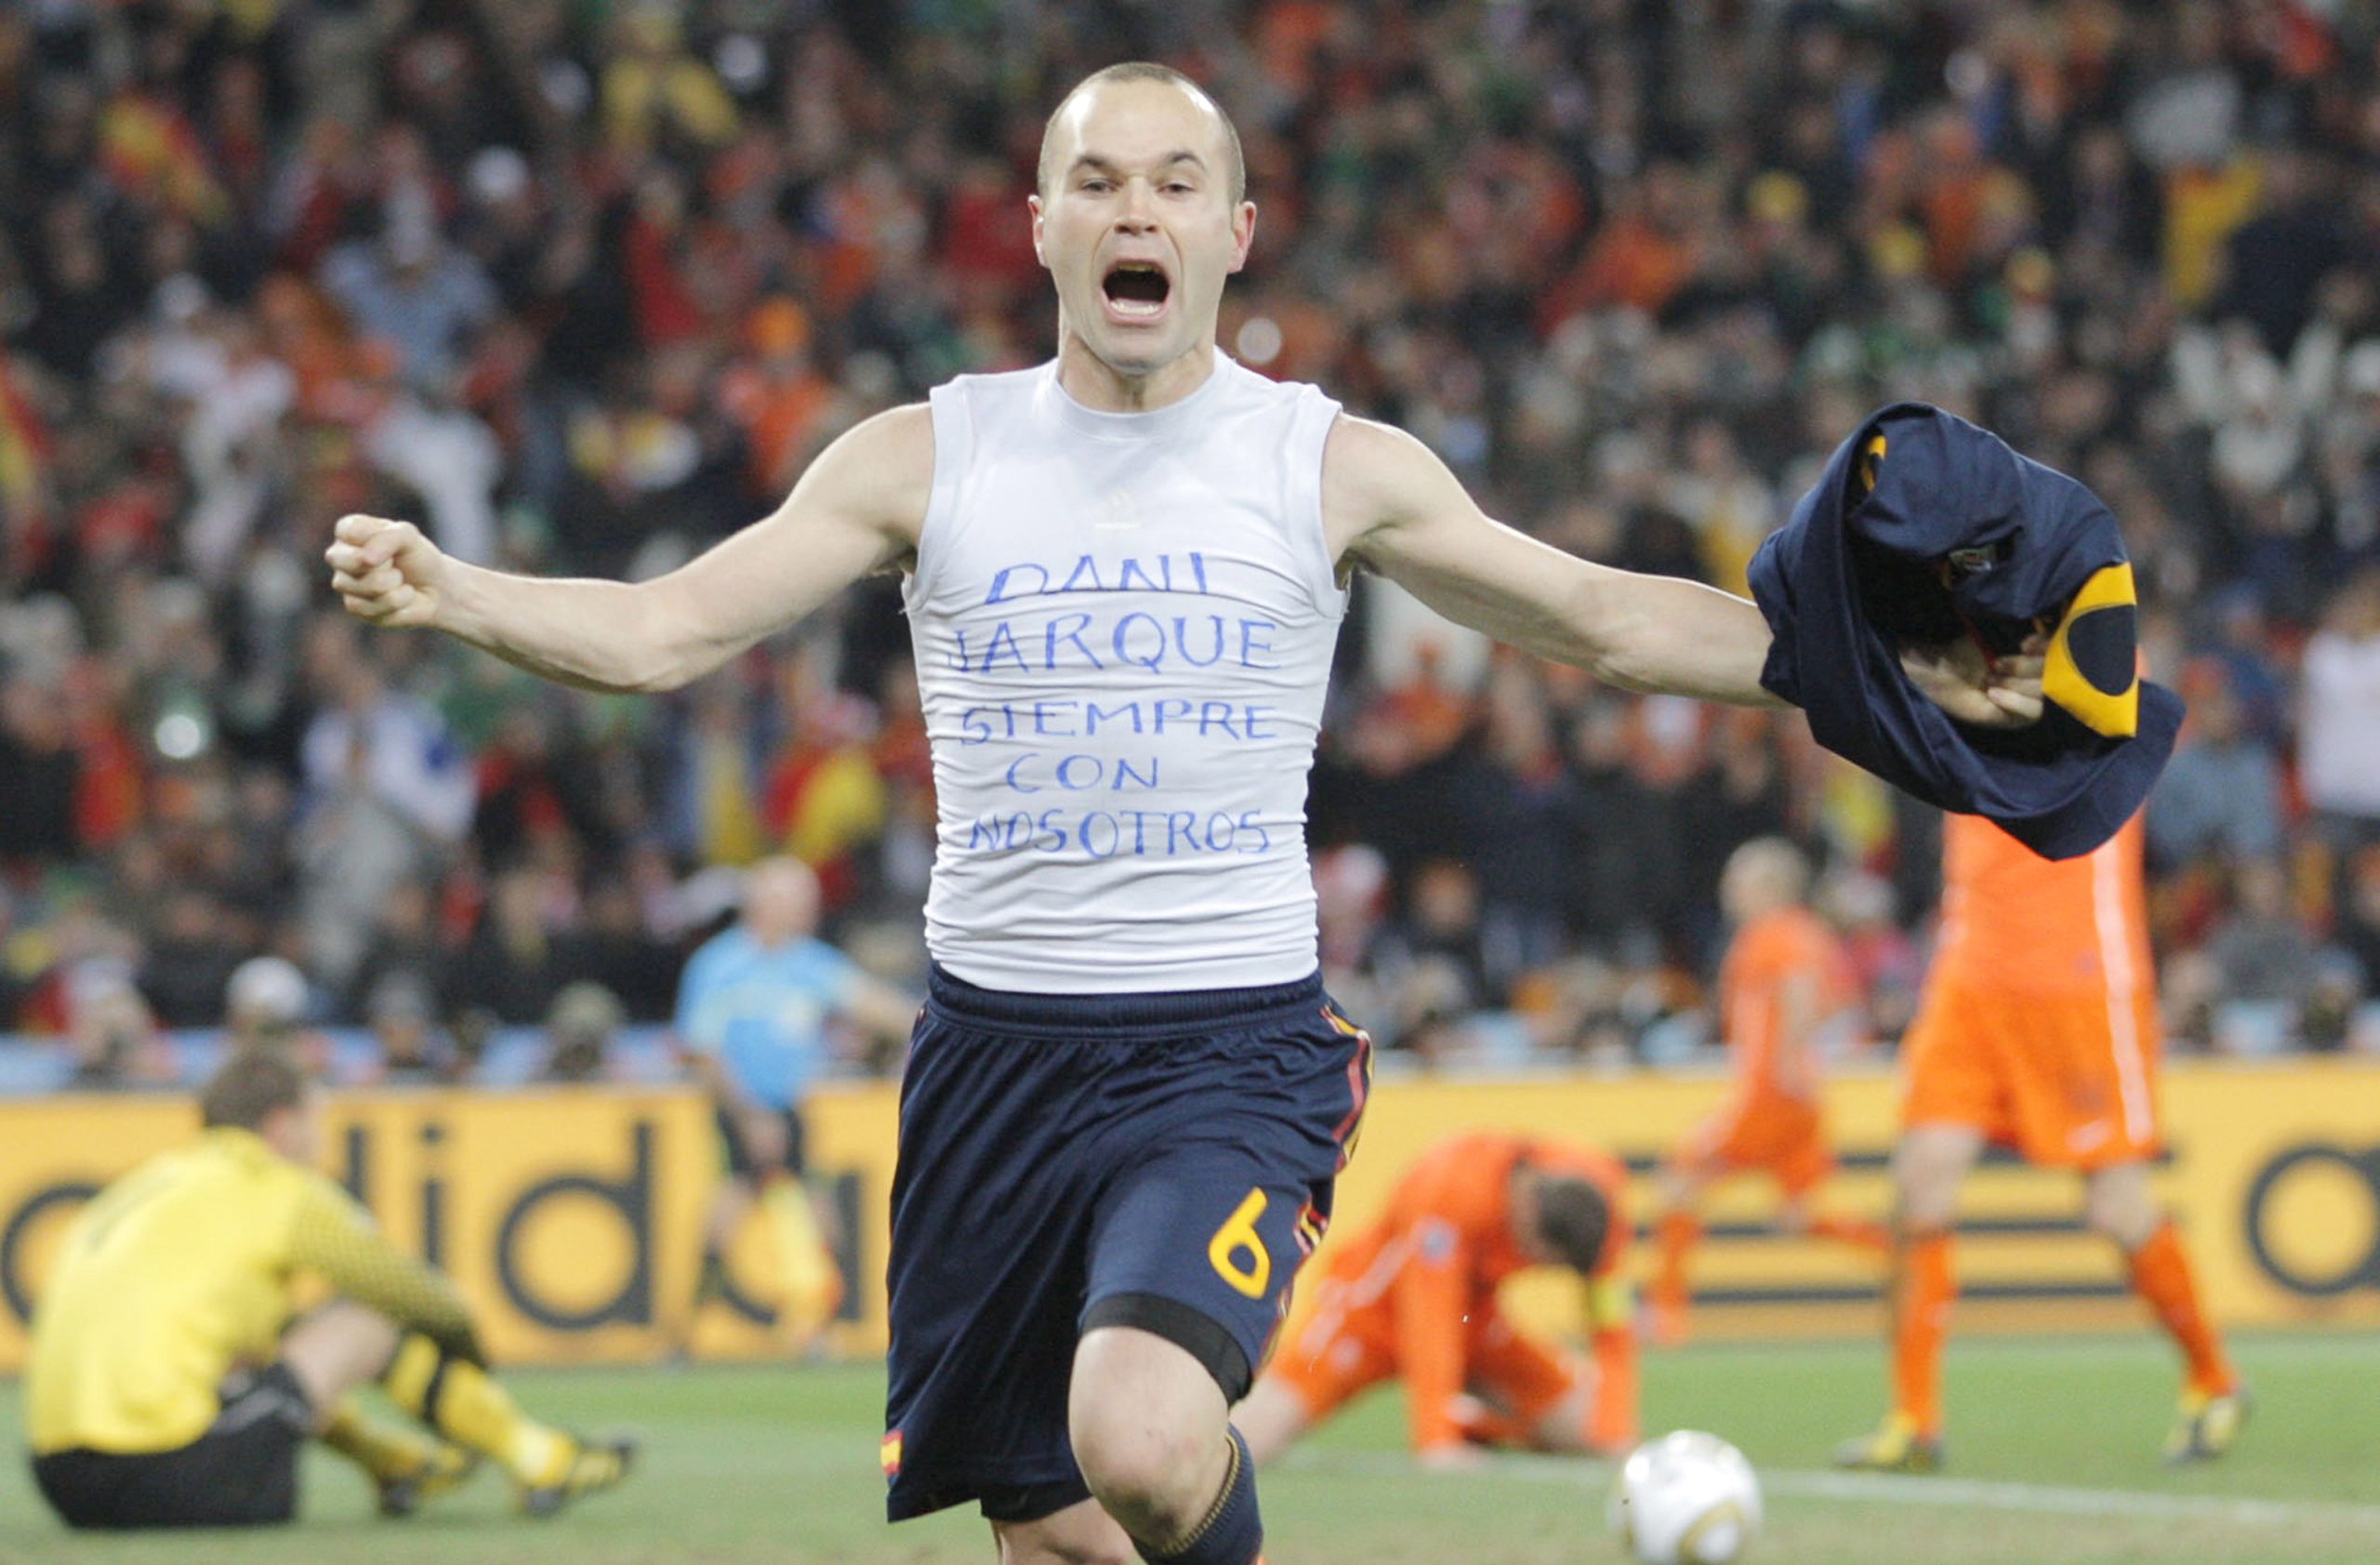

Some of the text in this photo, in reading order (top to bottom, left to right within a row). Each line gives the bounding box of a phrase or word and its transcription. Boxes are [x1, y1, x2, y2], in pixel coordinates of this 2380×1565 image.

[984, 551, 1209, 606] DANI
[946, 611, 1282, 676] JARQUE
[960, 698, 1278, 746] SIEMPRE
[1005, 753, 1159, 793] CON
[968, 808, 1272, 860] NOSOTROS
[1208, 1186, 1272, 1300] 6
